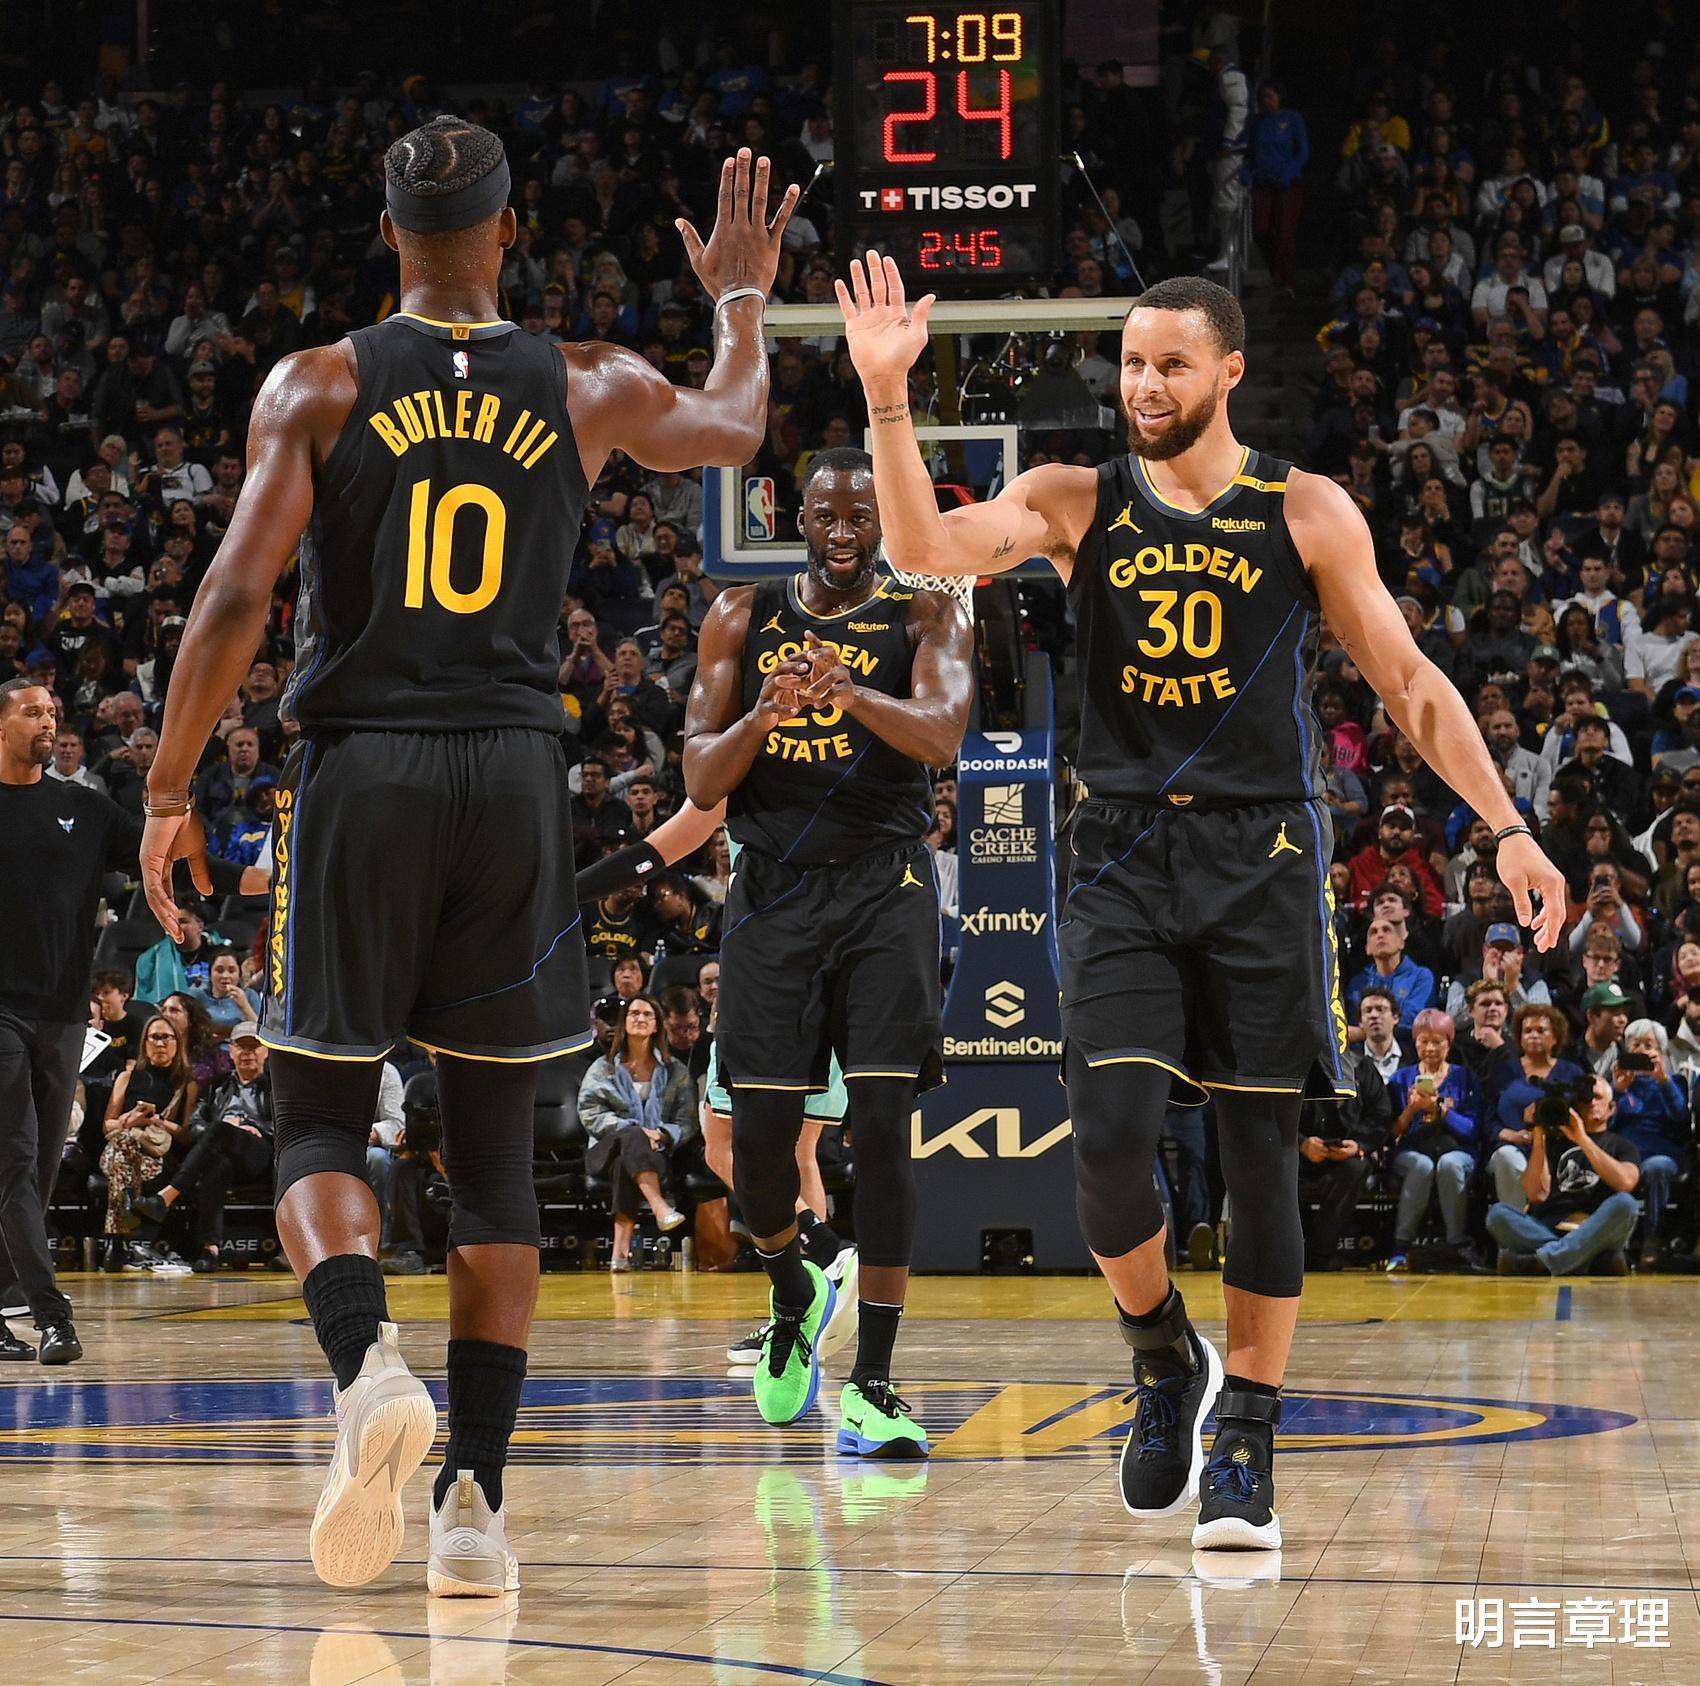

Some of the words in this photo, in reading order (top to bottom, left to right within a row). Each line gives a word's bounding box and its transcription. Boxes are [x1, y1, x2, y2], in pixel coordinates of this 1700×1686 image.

[906, 13, 1022, 63] 7:09
[883, 69, 1011, 162] 24
[907, 184, 1036, 210] TISSOT
[920, 230, 1003, 268] 2:45
[369, 390, 501, 457] BUTLER
[502, 409, 559, 470] III
[1211, 517, 1266, 533] Rakuten
[404, 478, 507, 615] 10
[1108, 543, 1263, 594] GOLDEN
[847, 621, 889, 633] Rakuten
[1136, 590, 1222, 659] 30
[1121, 664, 1237, 708] STATE
[766, 731, 853, 763] STATE
[959, 757, 1048, 772] DOORDASH
[969, 827, 1037, 843] CACHE
[970, 841, 1037, 856] CREEK
[971, 855, 1003, 865] CASINO
[1006, 854, 1038, 864] RESORT
[270, 788, 293, 997] WARRIORS
[960, 905, 1048, 936] xfinity
[590, 932, 637, 948] GOLDEN
